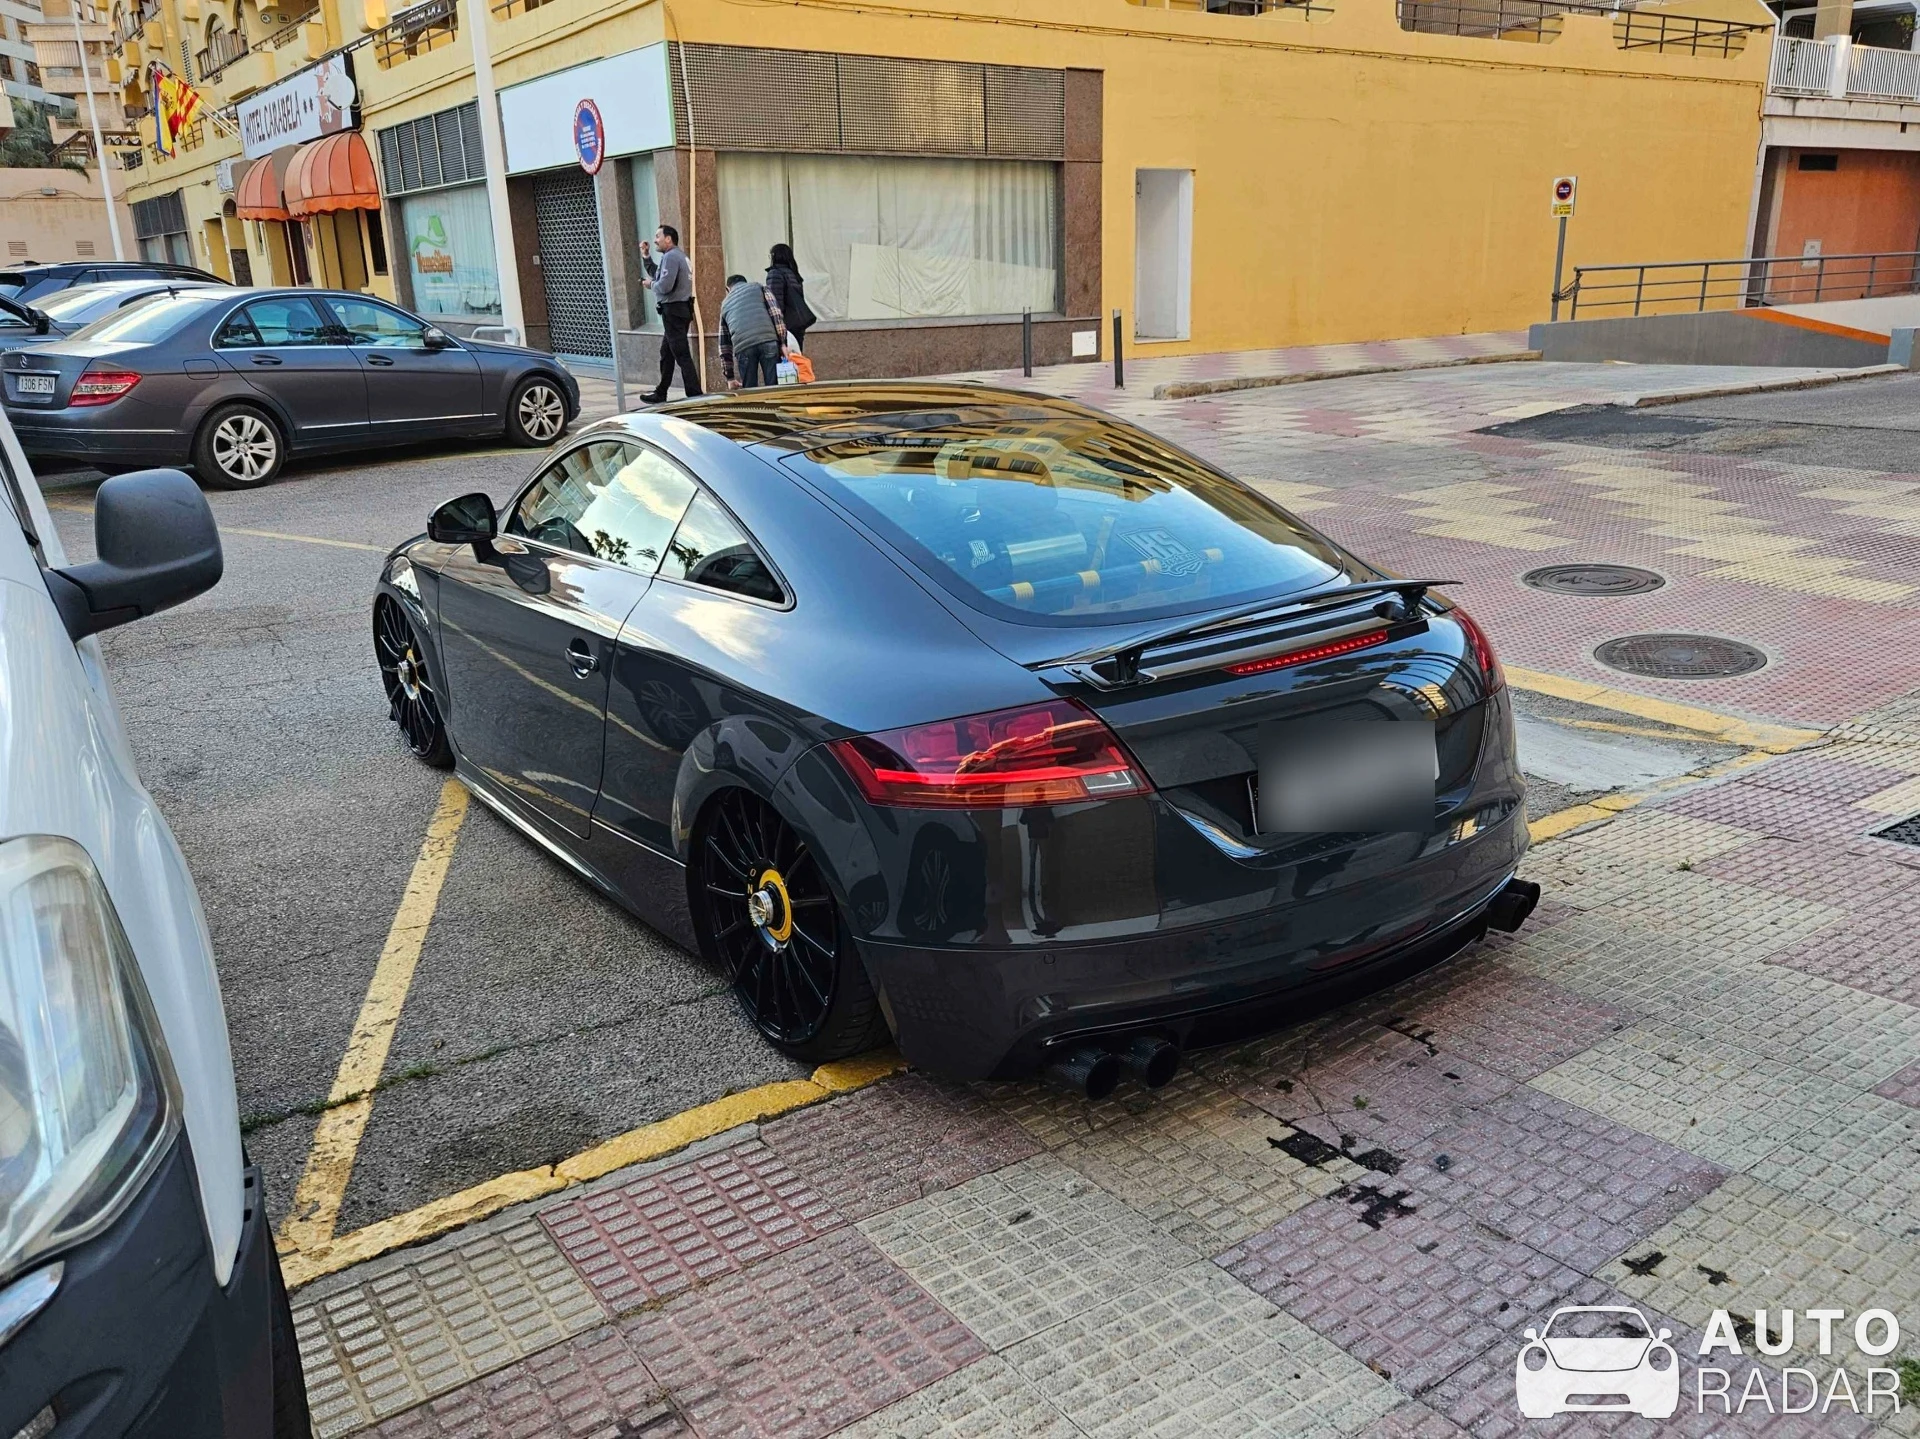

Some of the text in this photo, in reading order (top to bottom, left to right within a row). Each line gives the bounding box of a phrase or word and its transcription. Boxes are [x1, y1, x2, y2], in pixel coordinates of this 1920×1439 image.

[243, 91, 302, 146] HOTEL CARABELA
[21, 377, 53, 391] 1306 FSN
